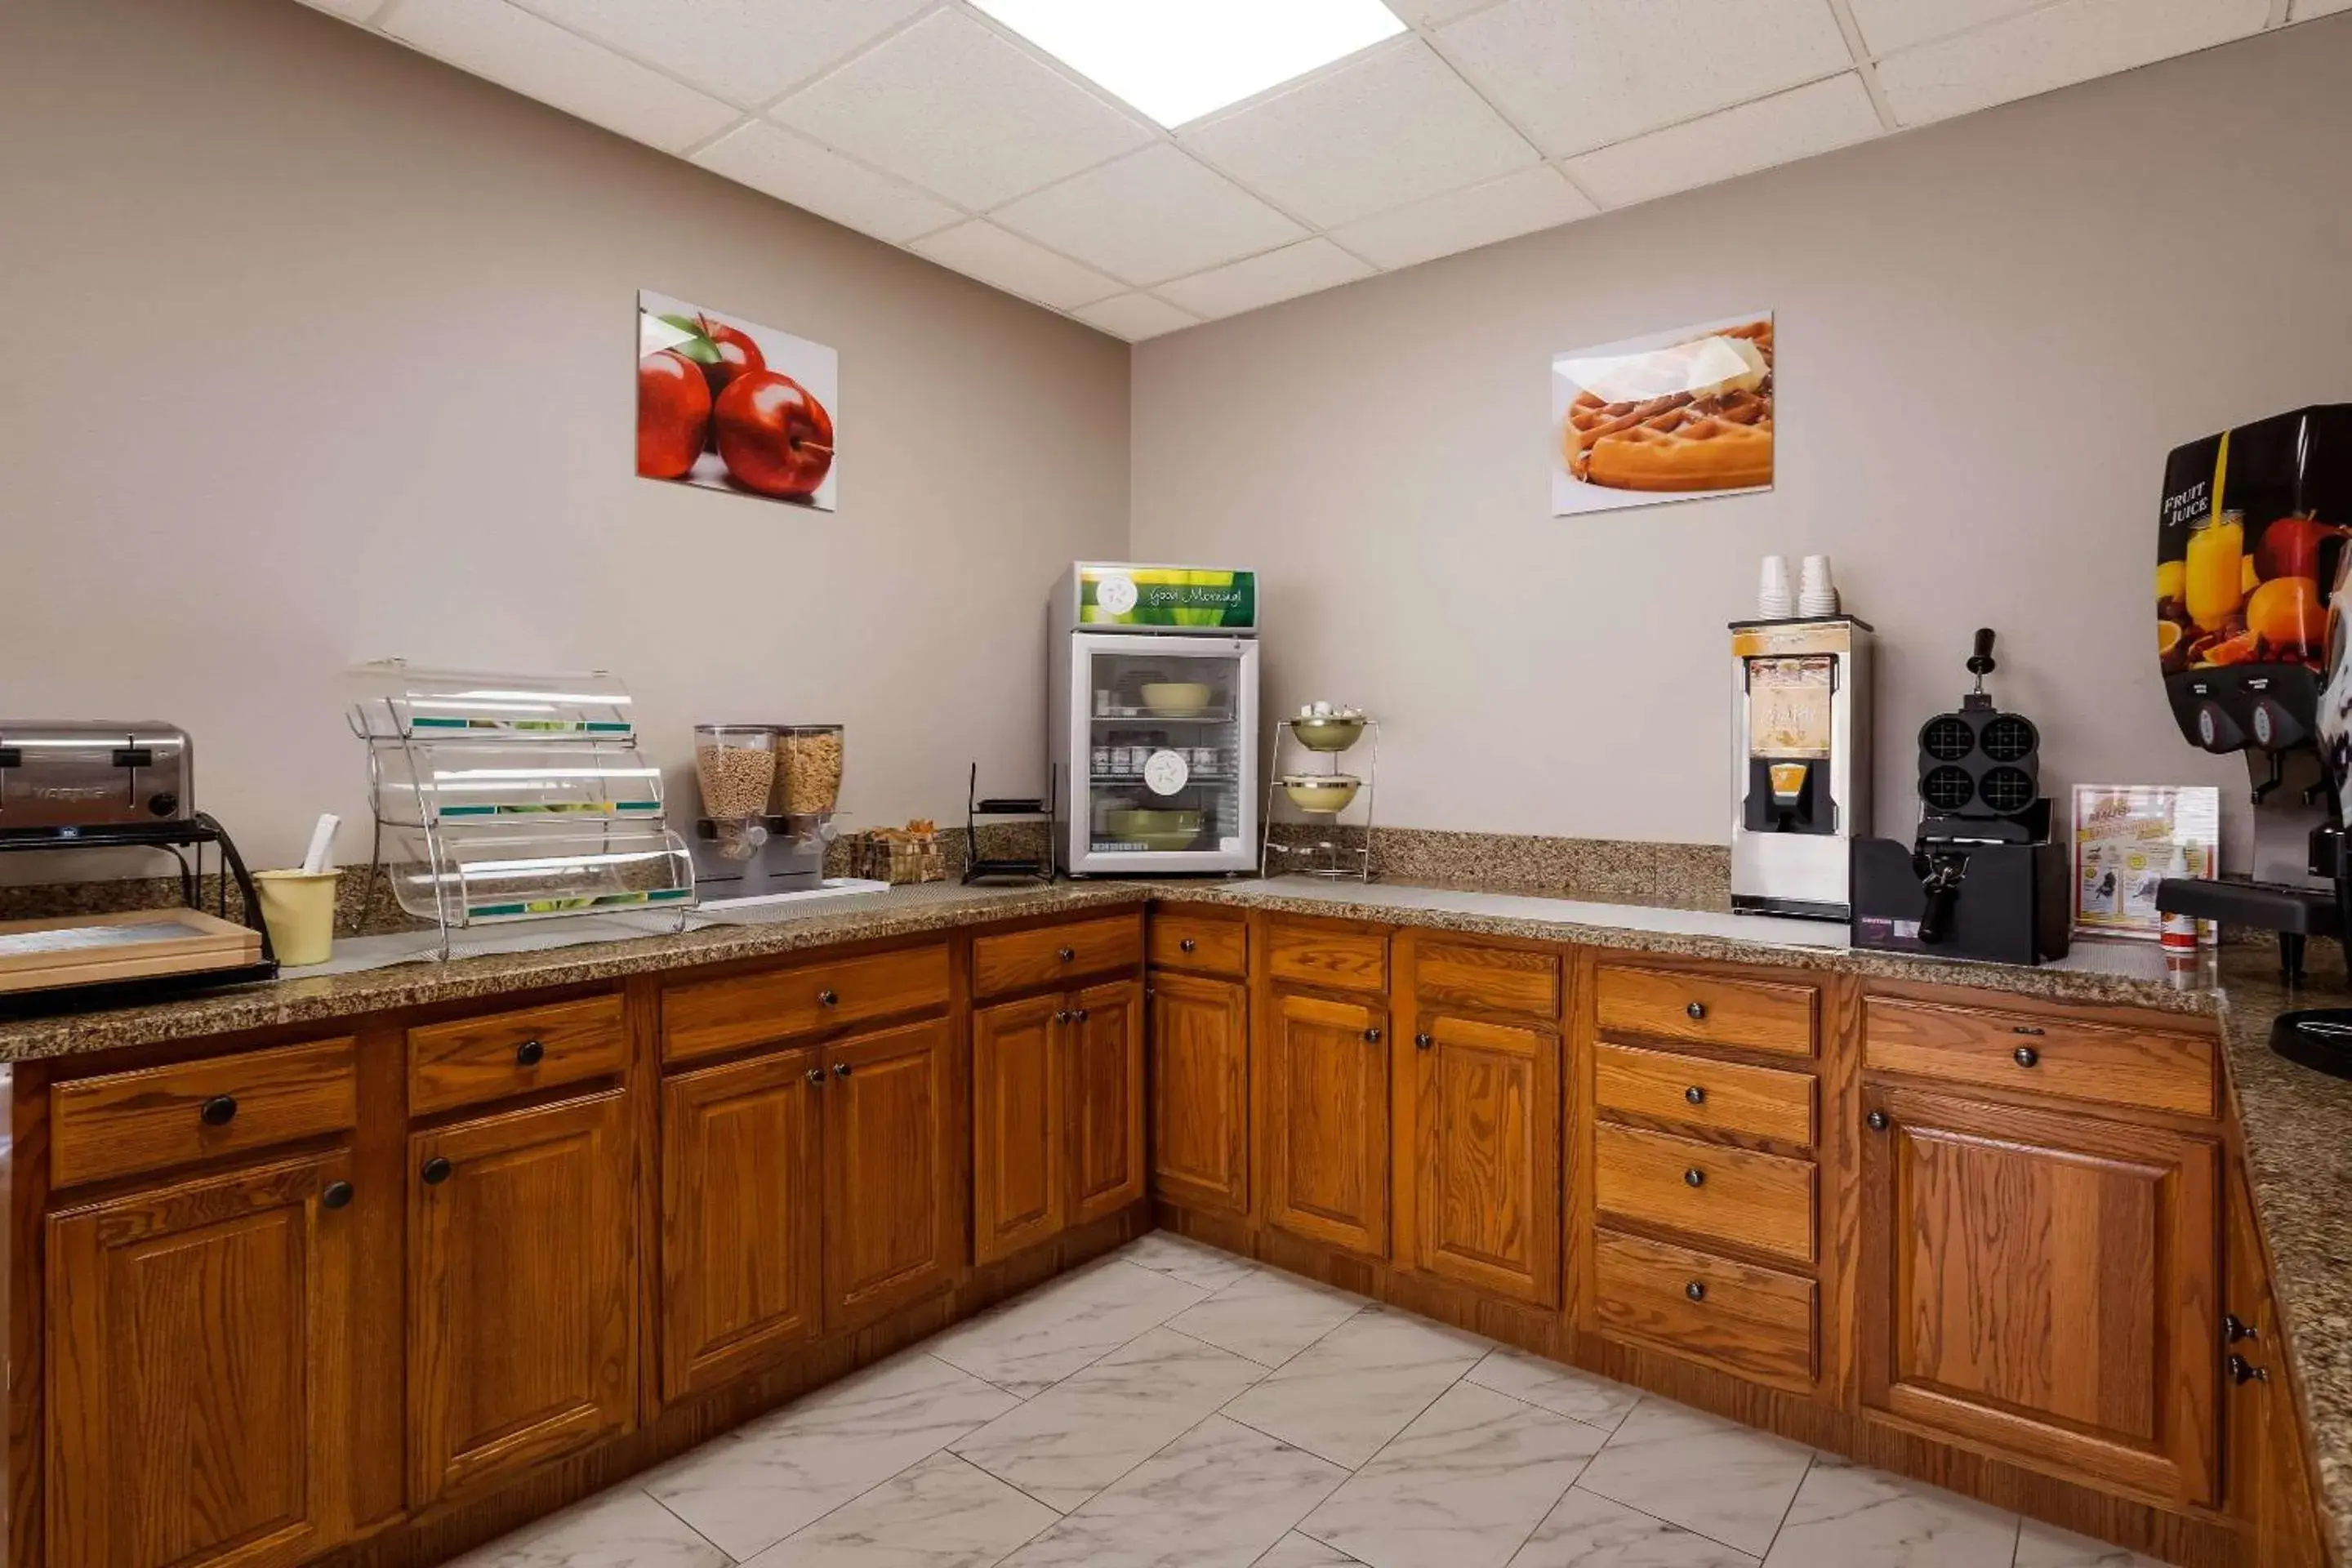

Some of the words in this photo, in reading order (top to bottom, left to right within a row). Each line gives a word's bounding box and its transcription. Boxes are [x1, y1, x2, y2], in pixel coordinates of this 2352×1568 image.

[2164, 481, 2206, 514] FRUIT
[2168, 497, 2208, 527] JUICE
[1149, 587, 1178, 607] Good
[1182, 586, 1242, 608] Morning!
